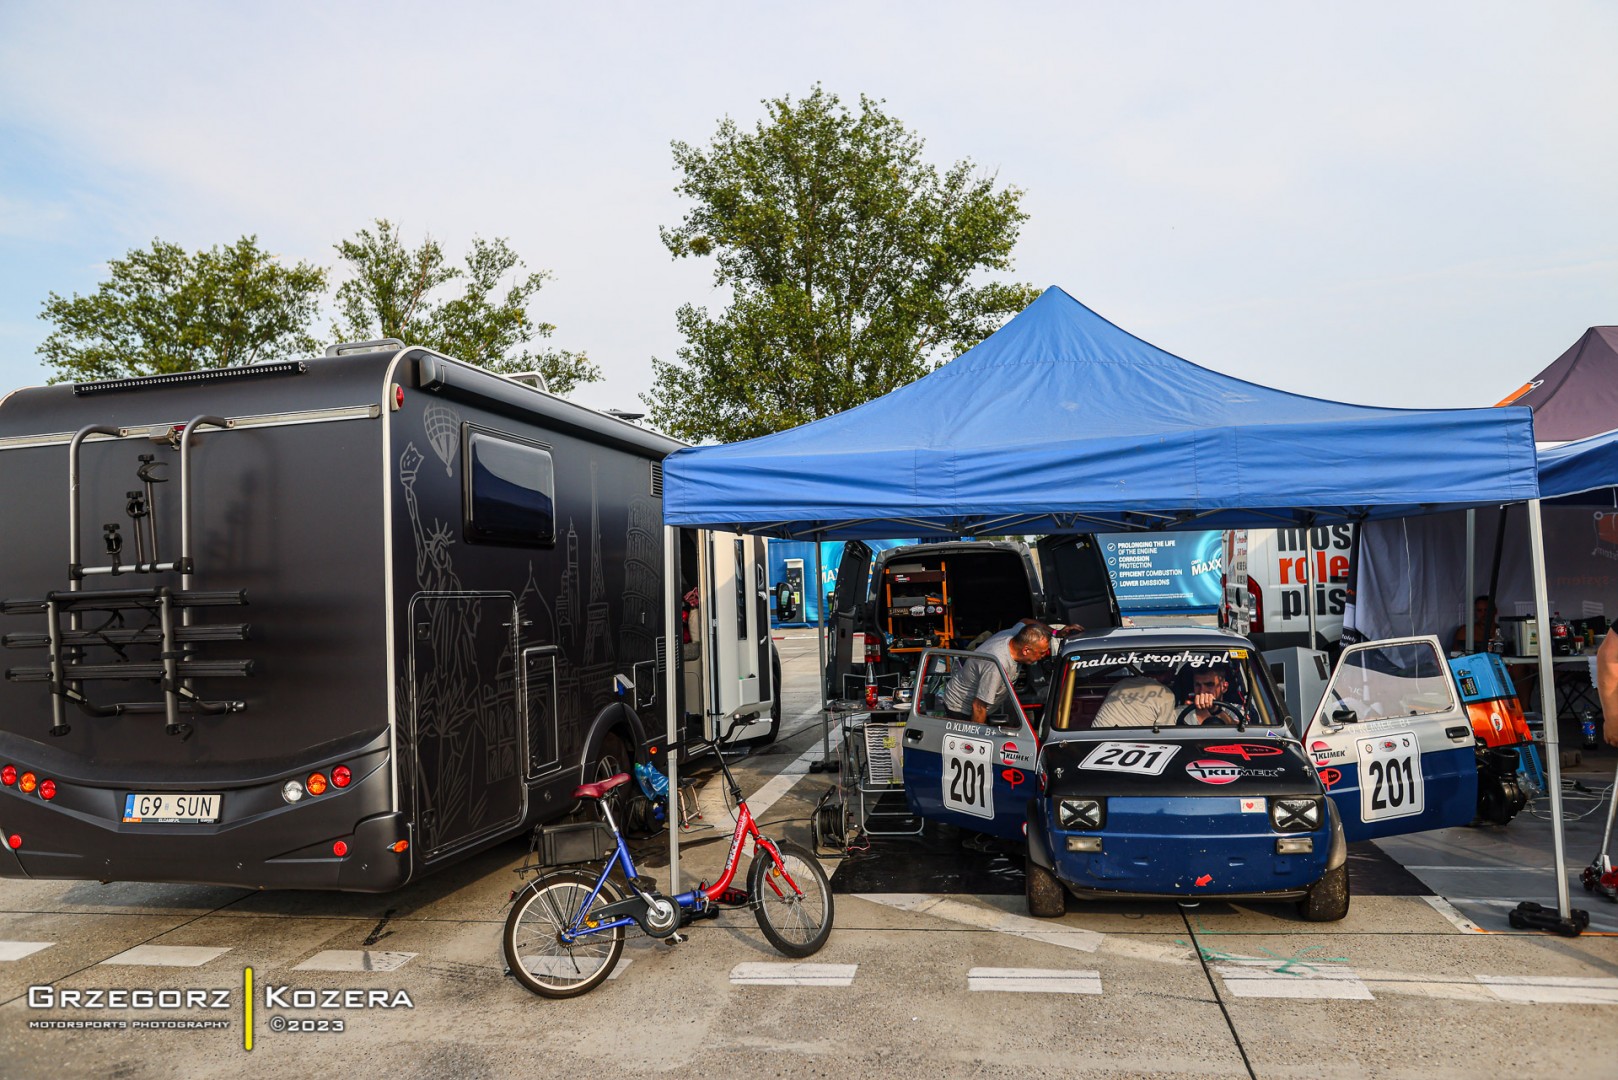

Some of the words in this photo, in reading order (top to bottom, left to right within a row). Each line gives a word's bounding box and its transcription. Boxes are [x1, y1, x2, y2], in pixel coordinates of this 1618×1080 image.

[1071, 650, 1229, 670] maluch-trophy.pl
[1005, 753, 1029, 761] KLIMEK
[1094, 749, 1162, 769] 201
[1318, 750, 1346, 760] KLIMEK
[950, 757, 985, 808] 201
[1208, 768, 1279, 777] KLIMEK
[1369, 756, 1415, 811] 201
[140, 796, 162, 816] G9
[175, 797, 212, 816] SUN
